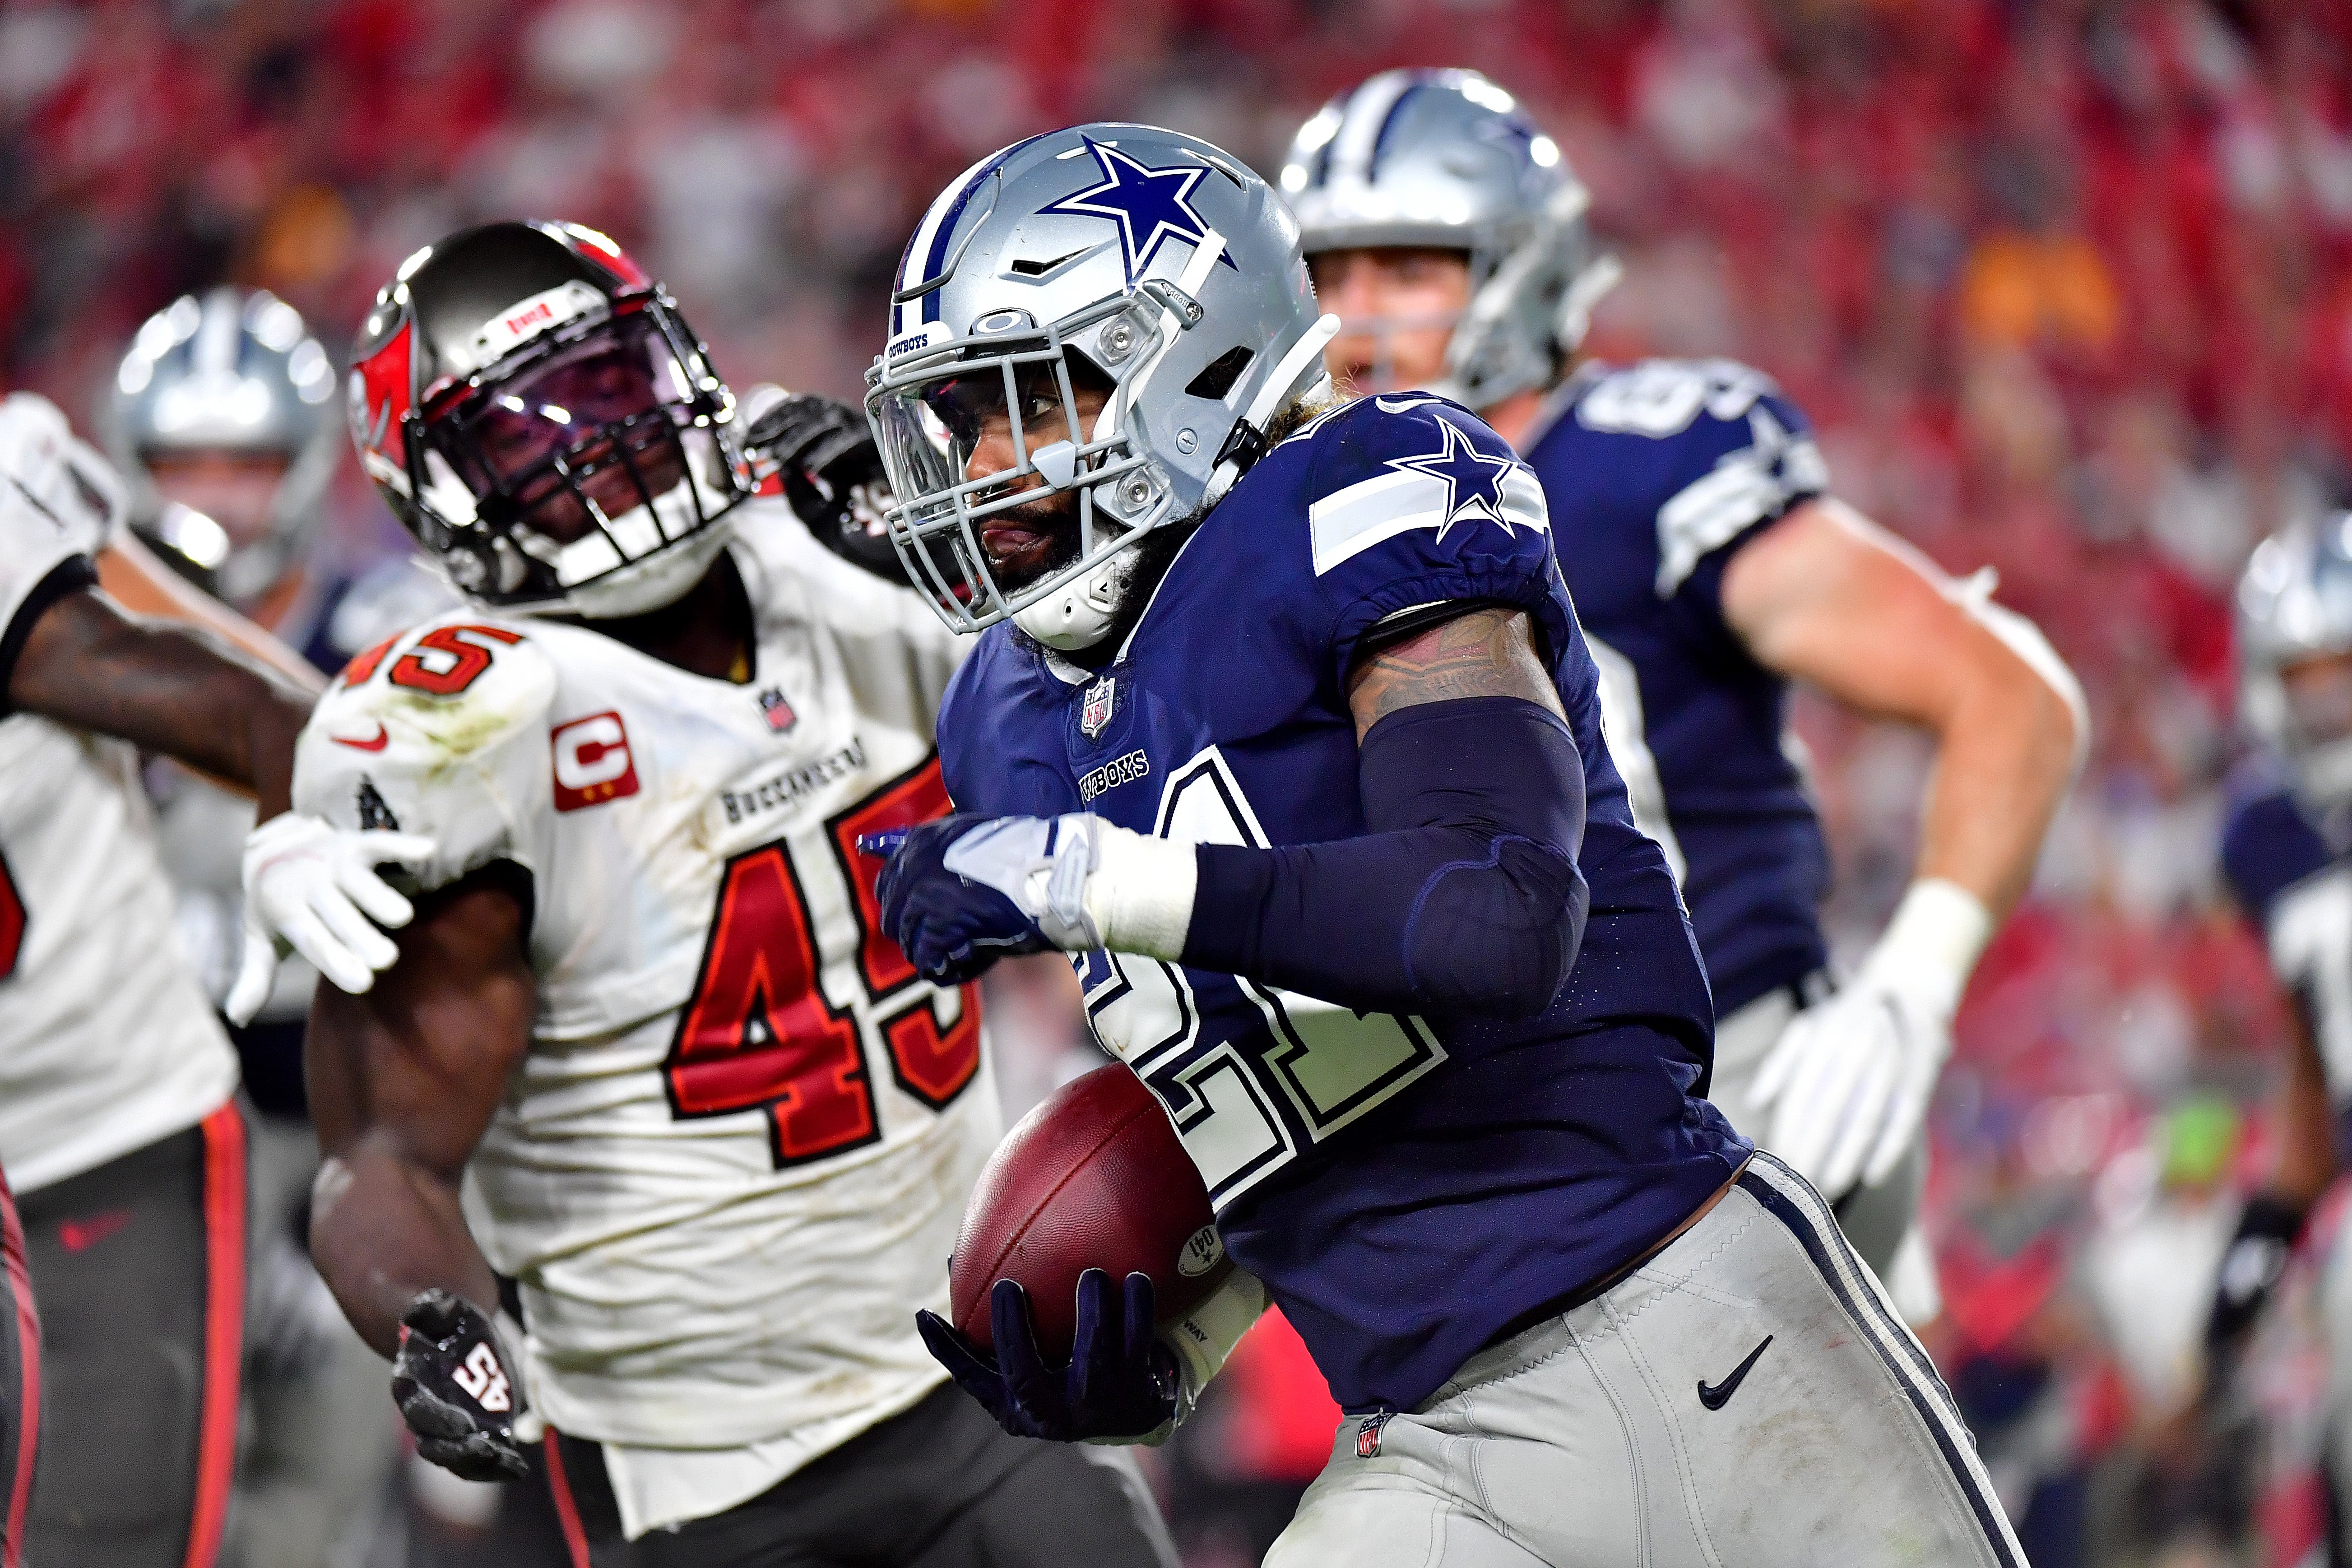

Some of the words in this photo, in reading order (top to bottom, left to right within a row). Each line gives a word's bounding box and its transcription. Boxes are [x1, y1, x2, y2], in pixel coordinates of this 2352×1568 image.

[889, 333, 928, 358] COWBOYS
[1086, 701, 1106, 725] NFL
[555, 714, 630, 790] C
[1078, 749, 1149, 803] WBOYS
[661, 747, 980, 1170] 45
[452, 1341, 511, 1413] 45
